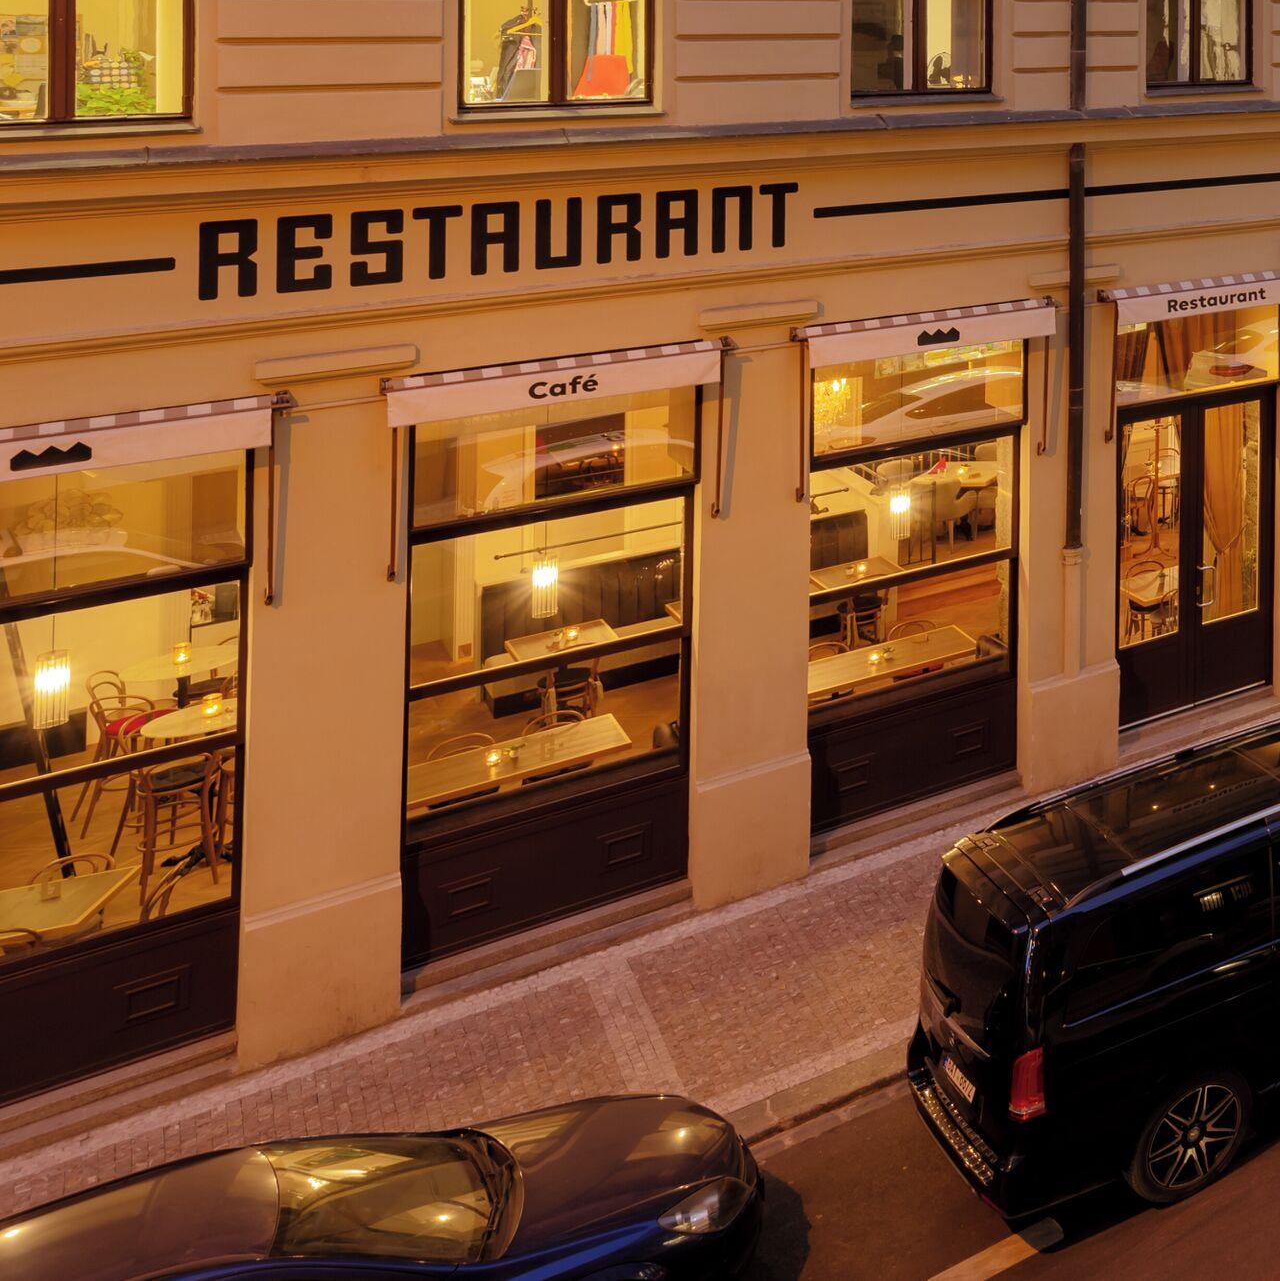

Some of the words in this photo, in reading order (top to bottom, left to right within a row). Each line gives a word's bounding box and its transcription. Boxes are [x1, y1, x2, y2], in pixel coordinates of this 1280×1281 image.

[198, 182, 799, 301] RESTAURANT
[1167, 288, 1266, 313] Restaurant
[528, 374, 599, 399] Café
